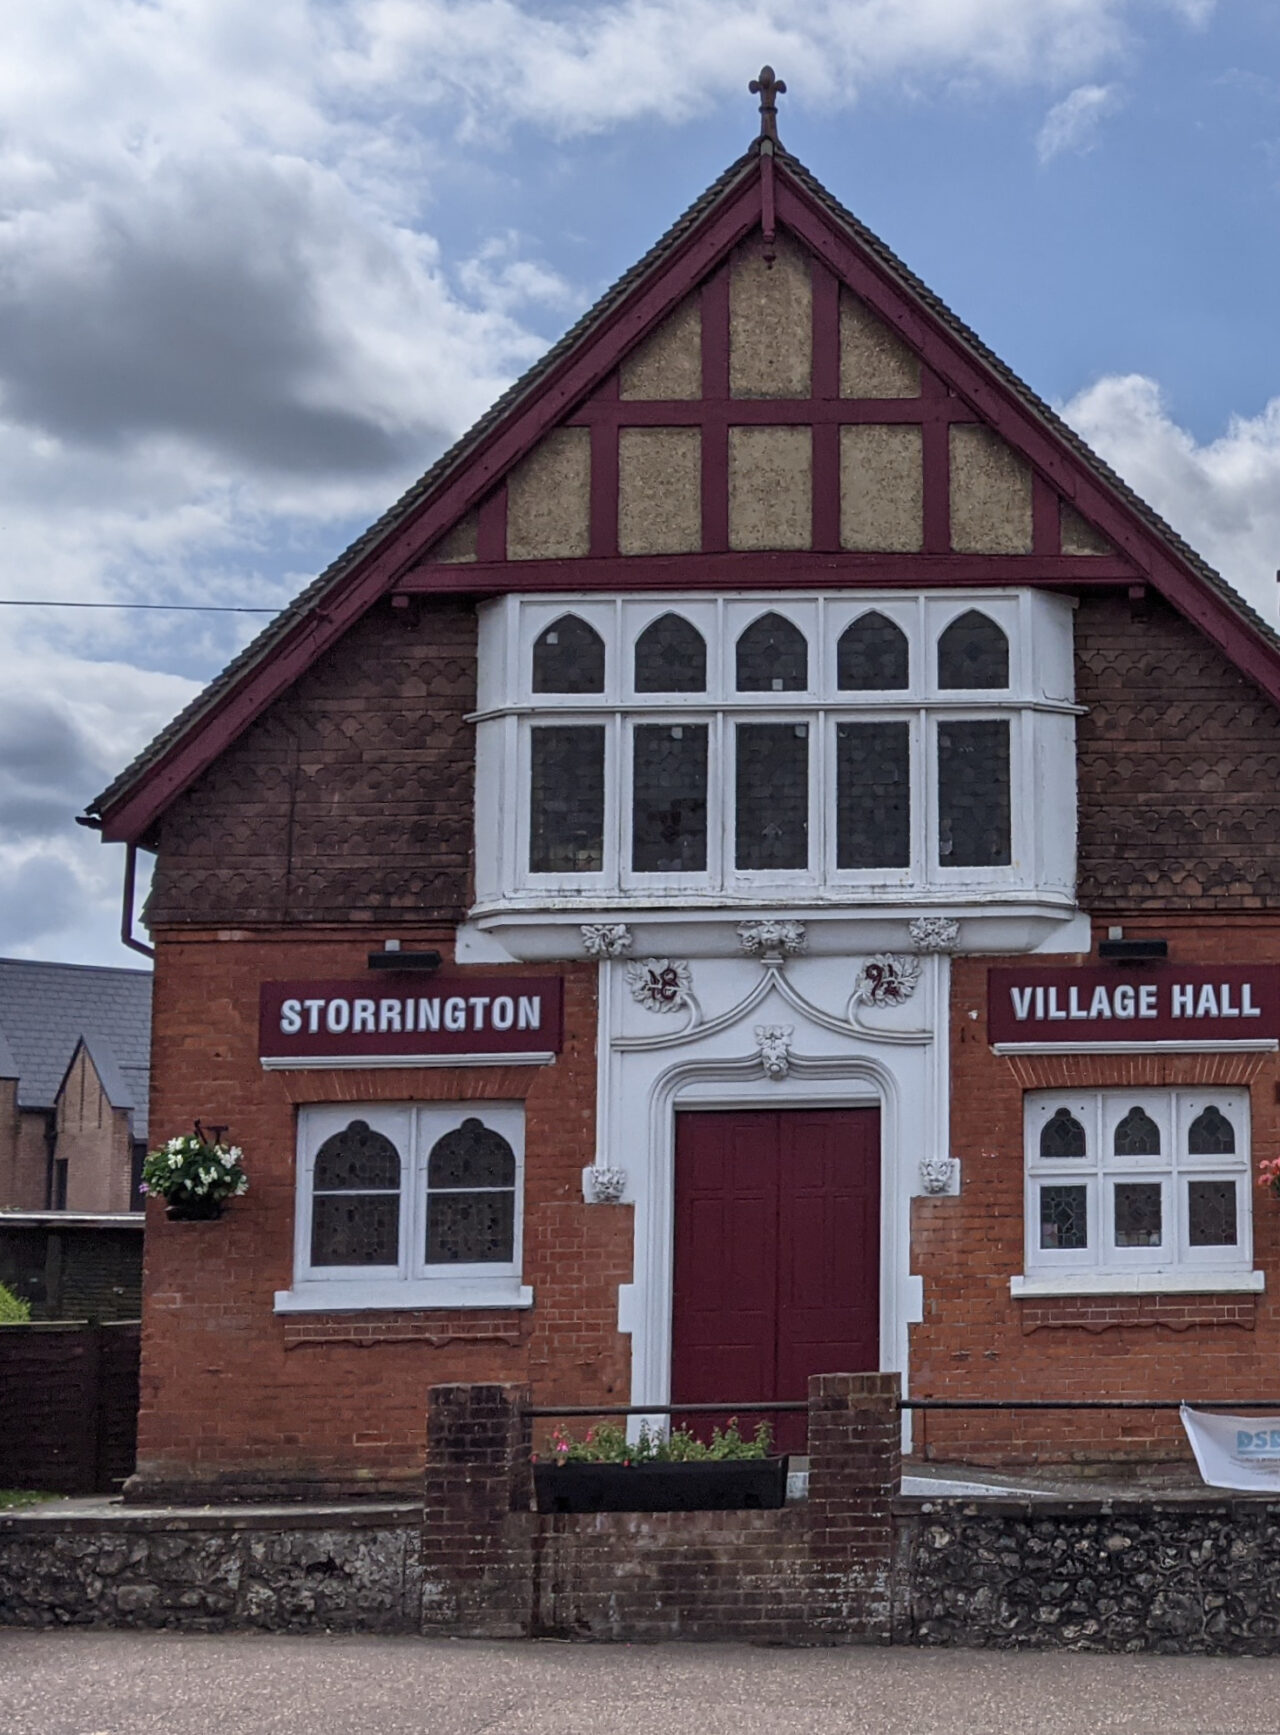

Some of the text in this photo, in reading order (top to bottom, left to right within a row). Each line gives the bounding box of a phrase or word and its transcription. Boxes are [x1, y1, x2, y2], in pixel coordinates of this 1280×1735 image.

[280, 996, 541, 1034] STORRINGTON
[1010, 983, 1261, 1020] VILLAGE HALL
